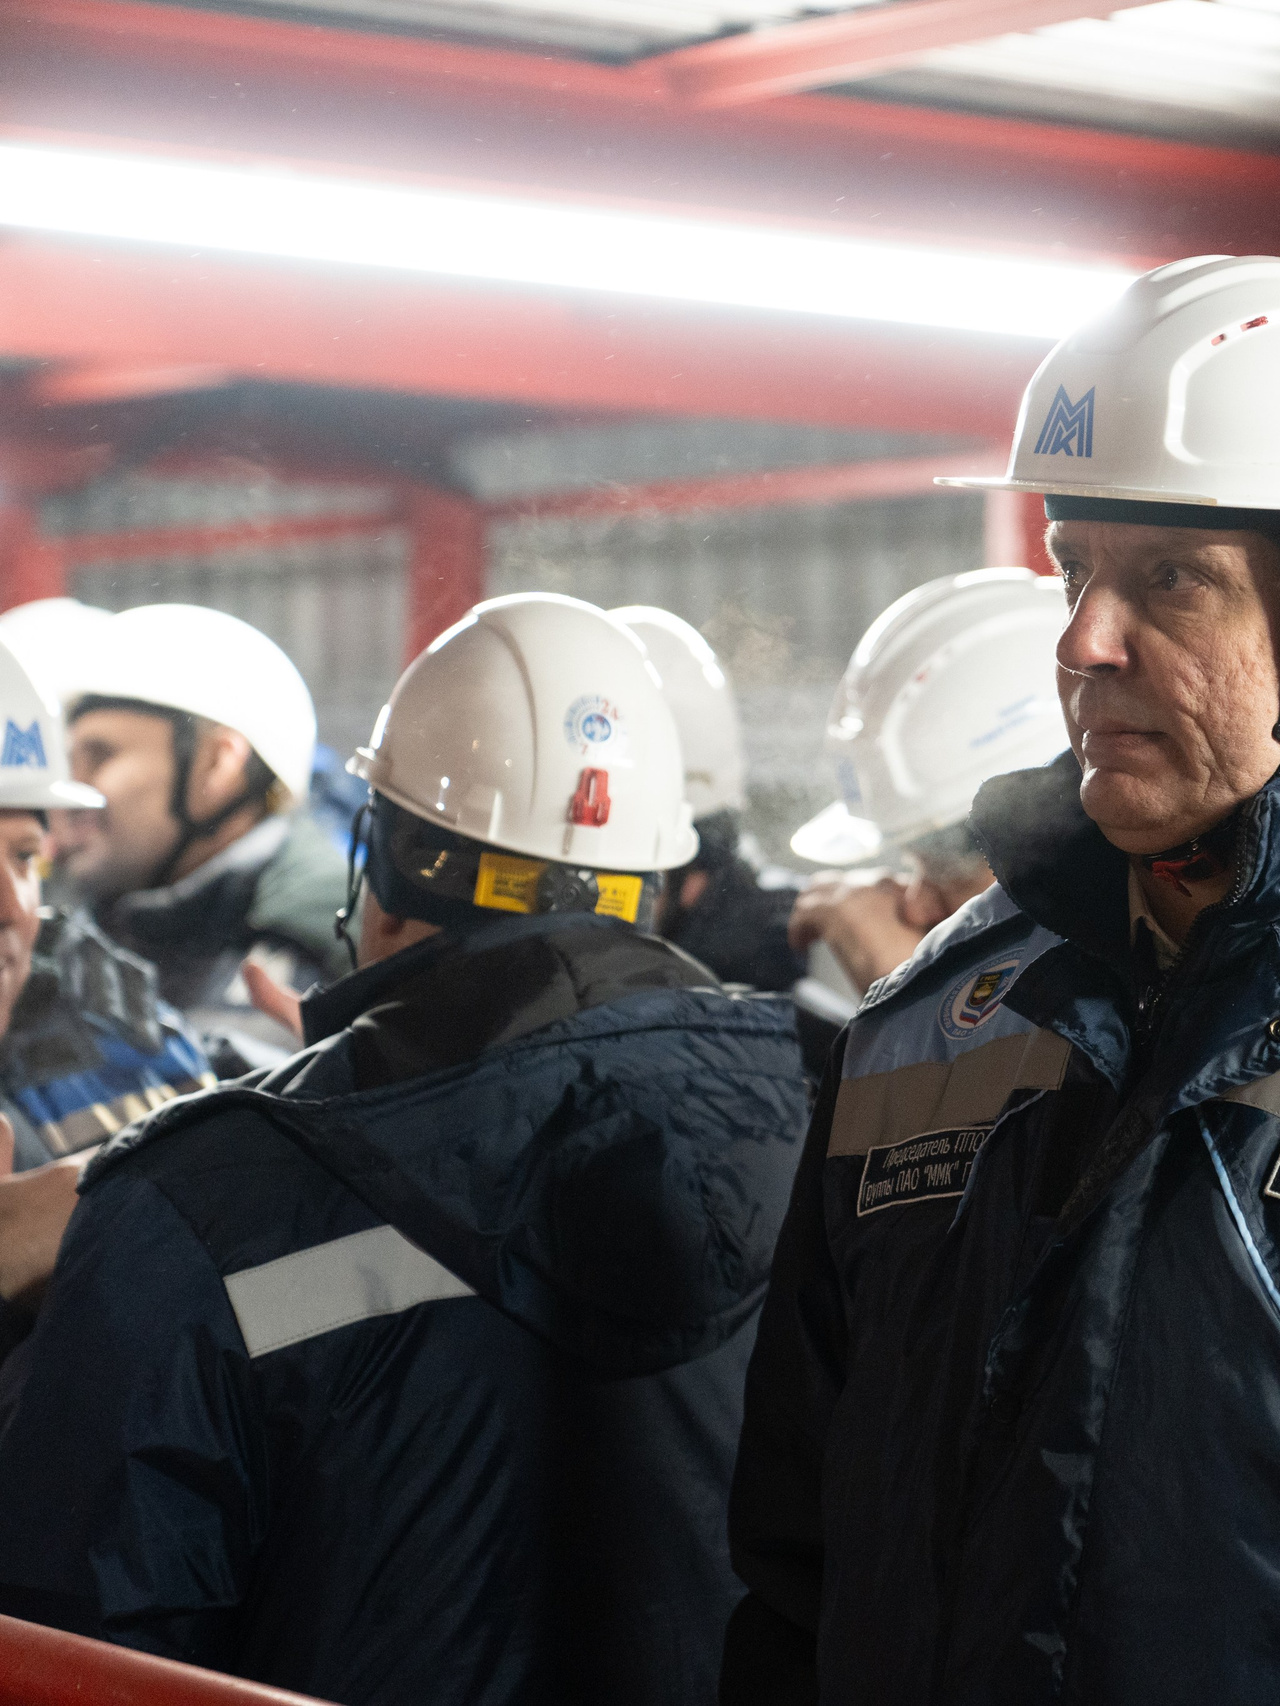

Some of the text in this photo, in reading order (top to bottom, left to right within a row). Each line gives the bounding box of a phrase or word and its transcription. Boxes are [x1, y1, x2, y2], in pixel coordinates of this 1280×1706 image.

[882, 1131, 985, 1172] Председатель ППО
[862, 1177, 895, 1207] Группы
[895, 1167, 920, 1193] ПАО
[924, 1159, 960, 1188] "ММК"
